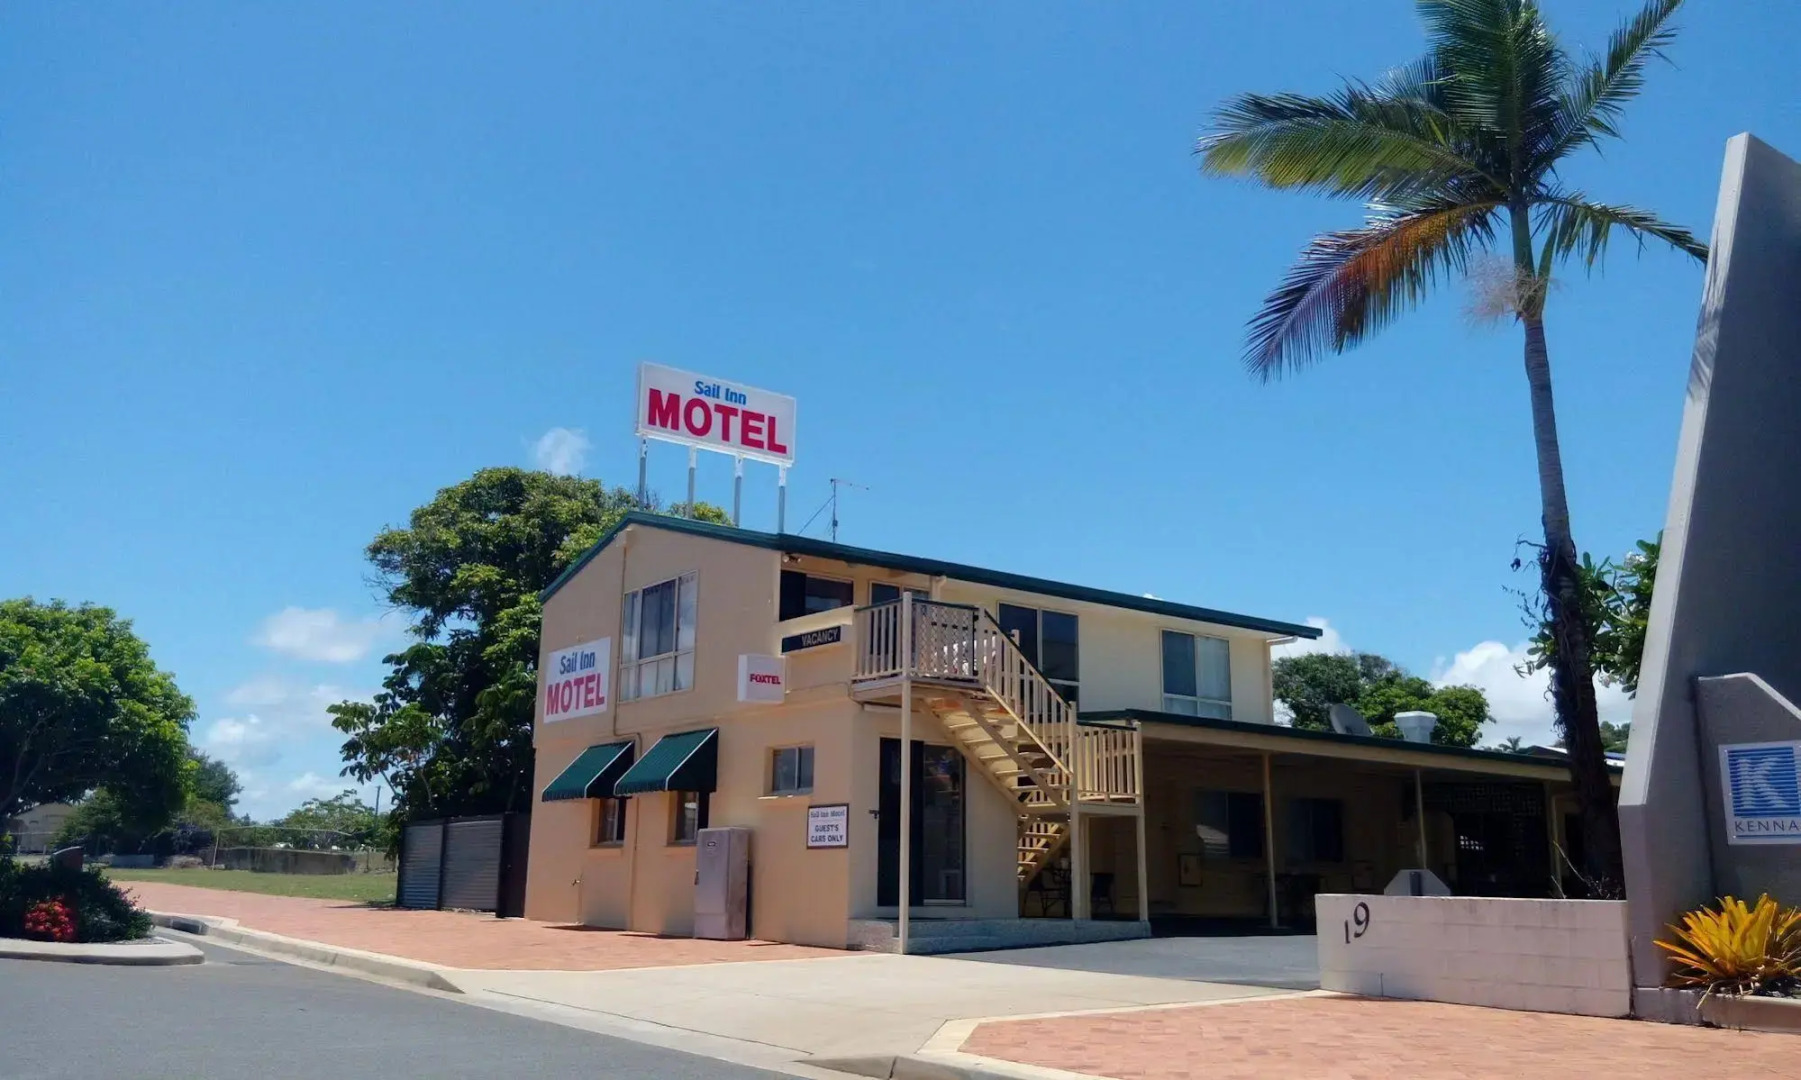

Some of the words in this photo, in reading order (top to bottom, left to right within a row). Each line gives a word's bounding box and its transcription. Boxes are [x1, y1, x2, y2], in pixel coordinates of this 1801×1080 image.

[694, 380, 720, 399] Sail
[725, 388, 747, 405] Inn
[648, 387, 787, 454] MOTEL
[801, 628, 839, 646] VACANCY
[560, 651, 578, 675] Sail
[580, 650, 596, 670] Inn
[749, 673, 781, 685] FOXTEL
[546, 673, 605, 716] MOTEL
[811, 835, 826, 843] CARS
[827, 834, 844, 842] ONLY
[1344, 901, 1370, 945] 19
